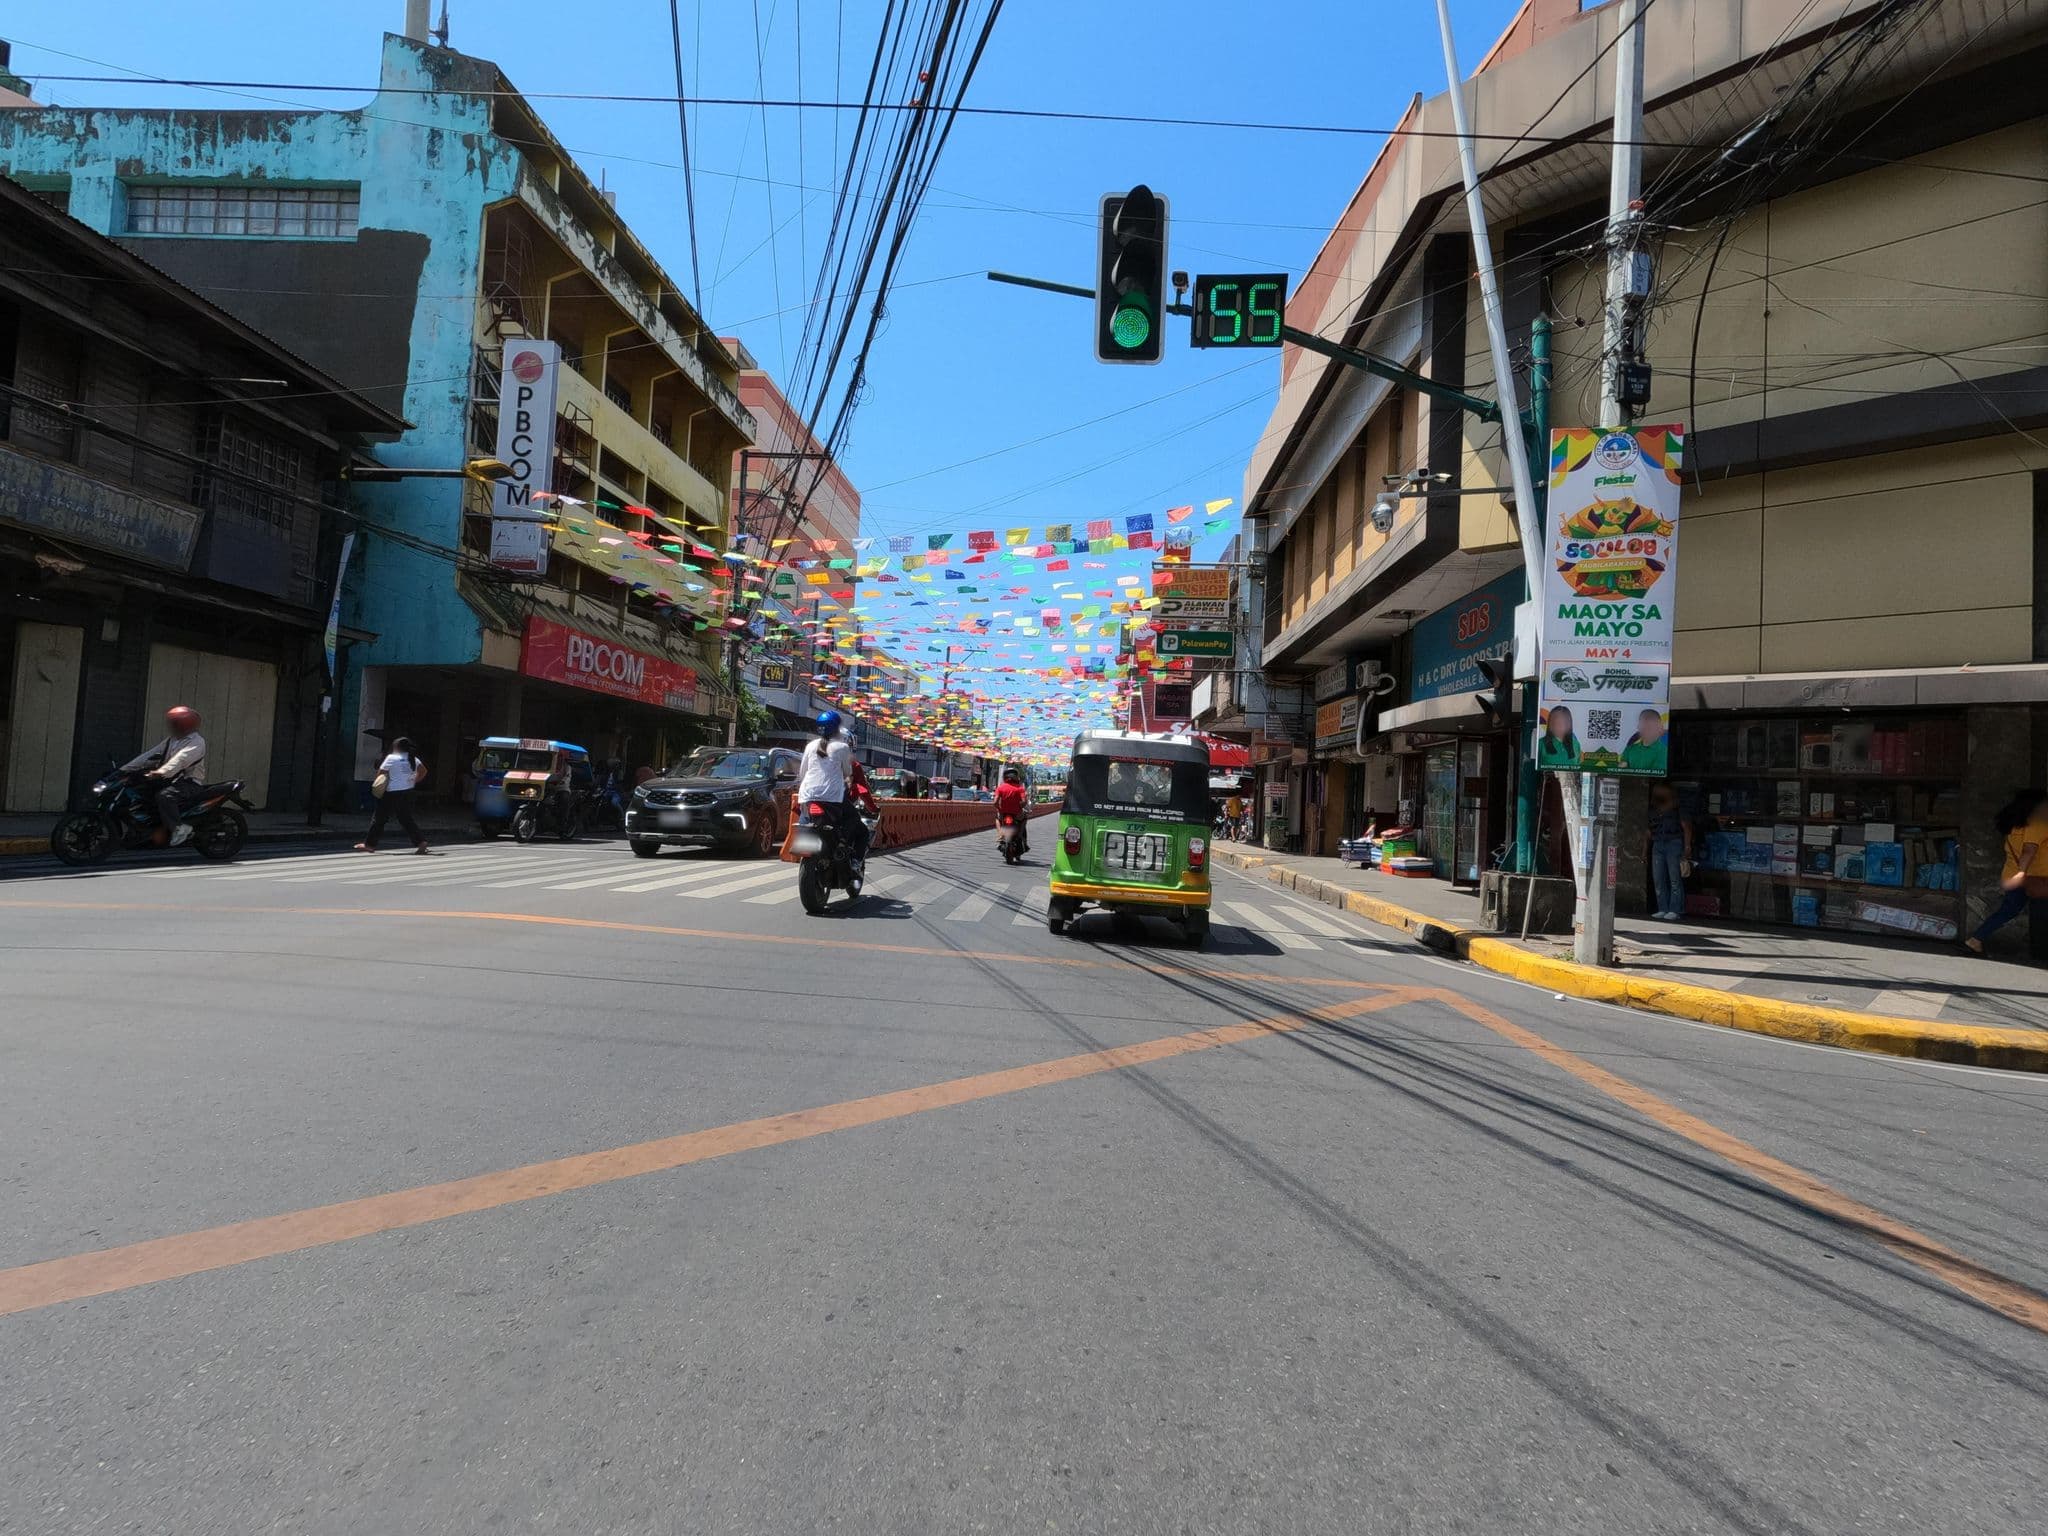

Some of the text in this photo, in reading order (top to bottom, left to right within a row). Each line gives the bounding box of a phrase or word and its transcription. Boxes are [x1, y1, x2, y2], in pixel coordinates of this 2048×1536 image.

[1210, 283, 1280, 343] 55
[506, 386, 533, 506] PBCOM
[1557, 603, 1663, 620] MAOY SA
[1458, 602, 1490, 641] SDS
[1574, 621, 1644, 638] MAYO
[1181, 639, 1229, 650] PalawanPay
[1585, 648, 1632, 658] MAY 4
[1630, 640, 1669, 648] FREESTYLE
[566, 634, 645, 687] PBCOM
[1432, 668, 1440, 682] C
[1440, 660, 1458, 679] DRY
[1459, 647, 1494, 673] GOODS
[1439, 677, 1478, 696] WHOLESALE
[1126, 823, 1146, 832] TVS
